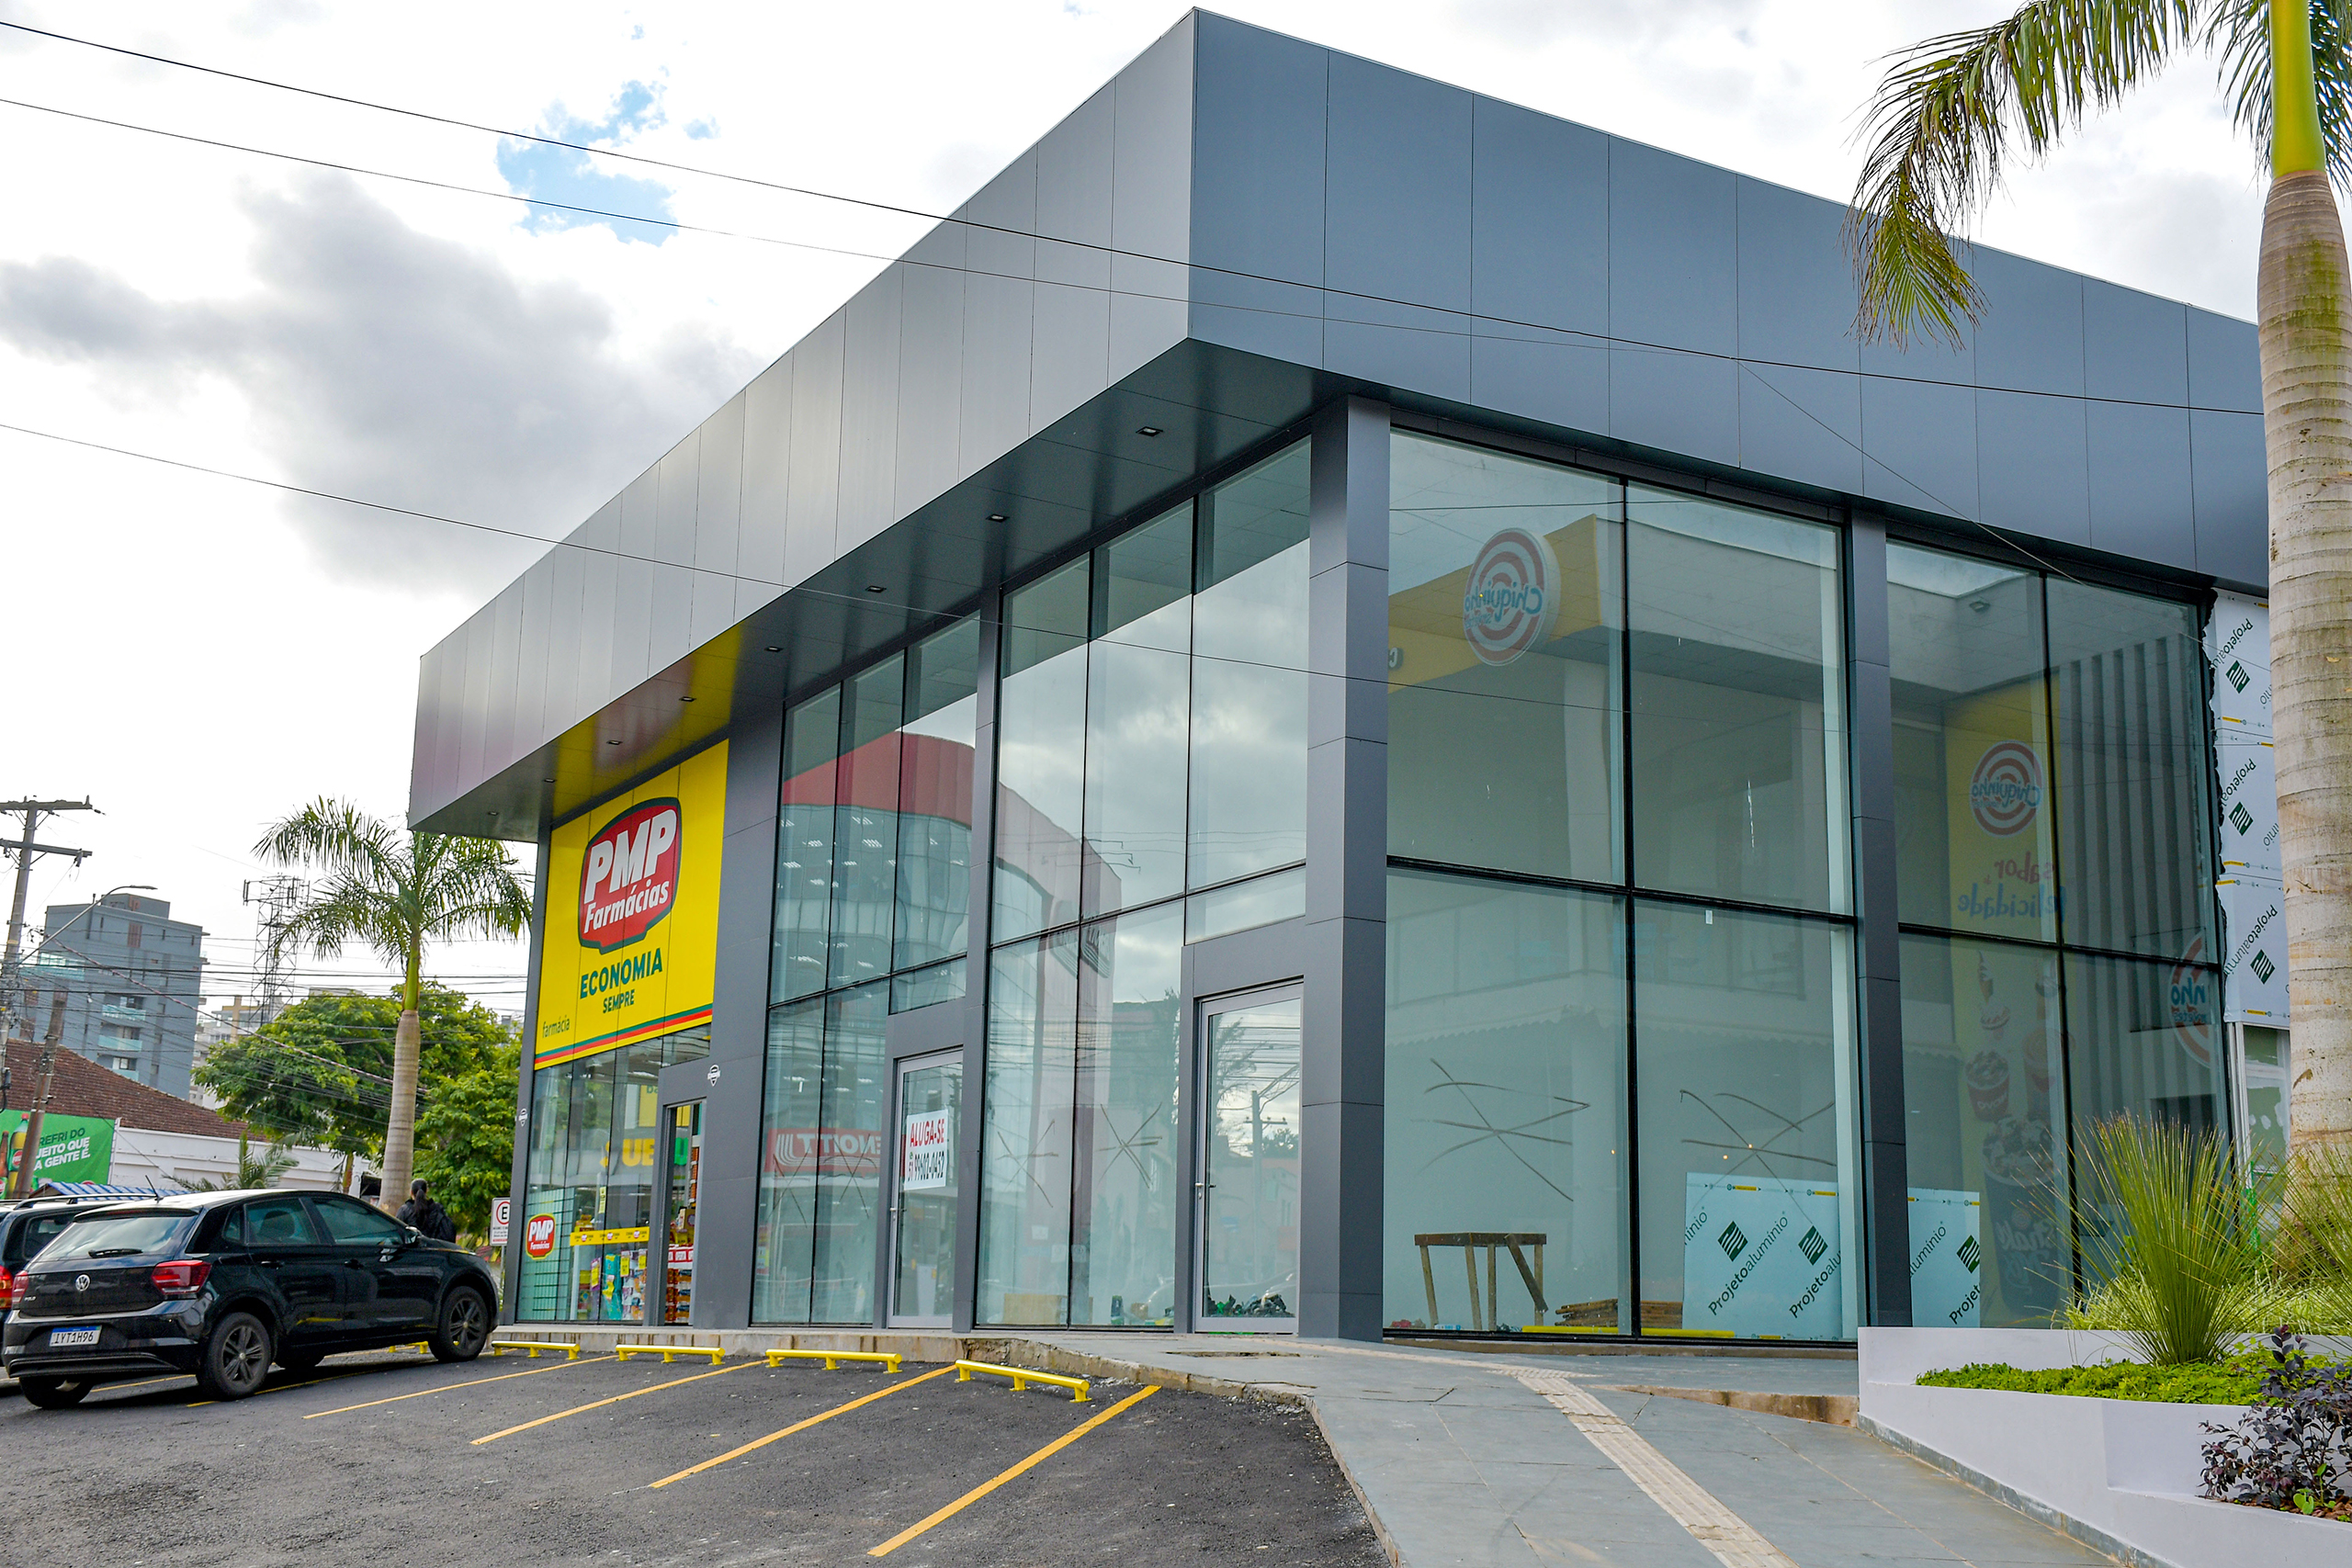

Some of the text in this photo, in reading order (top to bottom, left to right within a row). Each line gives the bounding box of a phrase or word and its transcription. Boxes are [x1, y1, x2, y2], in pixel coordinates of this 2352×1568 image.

[583, 808, 677, 905] PMP
[583, 878, 670, 934] Farmácias
[580, 947, 663, 999] ECONOMIA
[603, 988, 636, 1013] SEMPRE
[542, 1014, 570, 1039] farmácia
[40, 1127, 85, 1145] REFRI DO
[910, 1118, 945, 1147] ALUGA-SE
[34, 1160, 42, 1171] A
[44, 1149, 80, 1168] GENTE
[36, 1143, 65, 1159] JEITO
[67, 1136, 90, 1151] QUE
[502, 1206, 508, 1220] E
[528, 1219, 554, 1242] PMP
